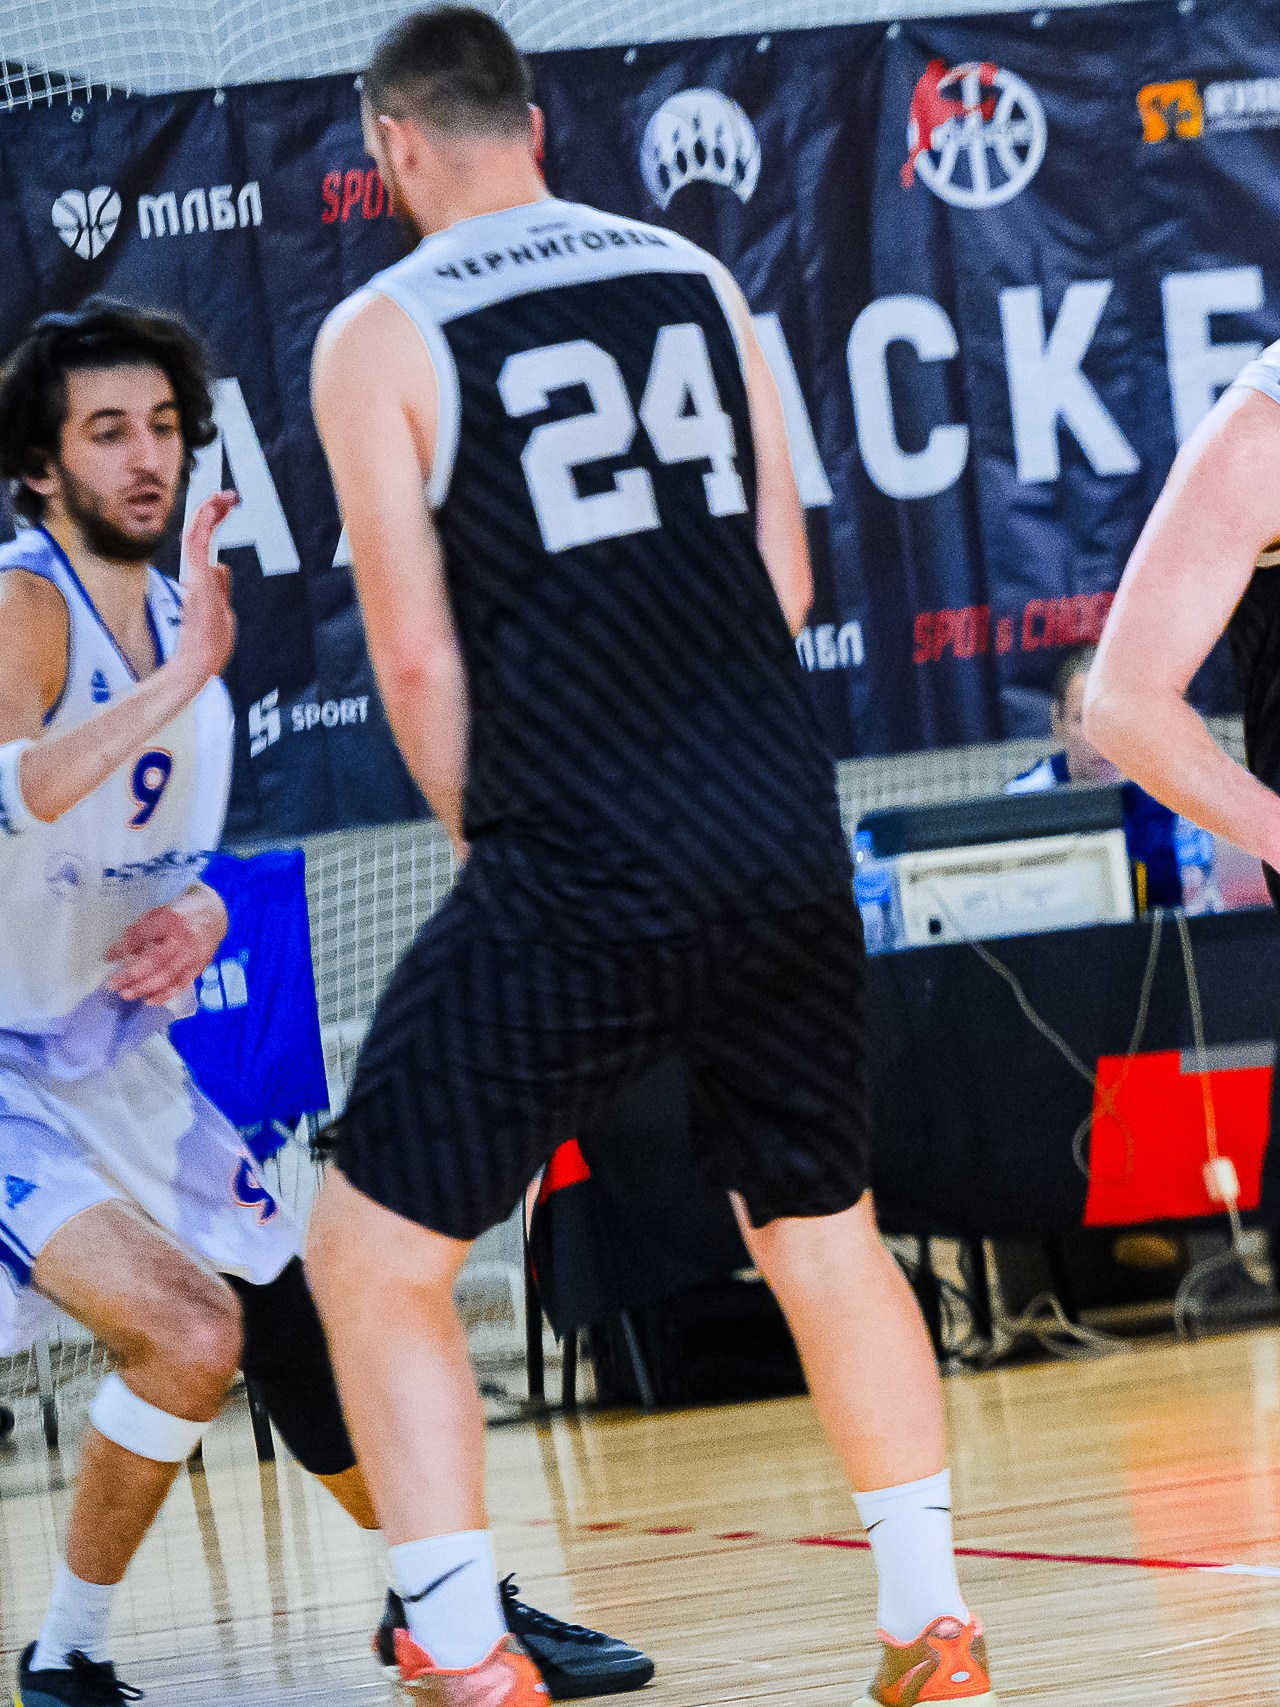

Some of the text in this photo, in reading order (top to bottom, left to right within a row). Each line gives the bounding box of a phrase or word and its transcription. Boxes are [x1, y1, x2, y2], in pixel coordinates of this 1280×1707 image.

[498, 322, 749, 554] 24
[795, 619, 865, 672] ЛБЛ
[291, 694, 370, 733] SPORT
[129, 747, 172, 830] 9
